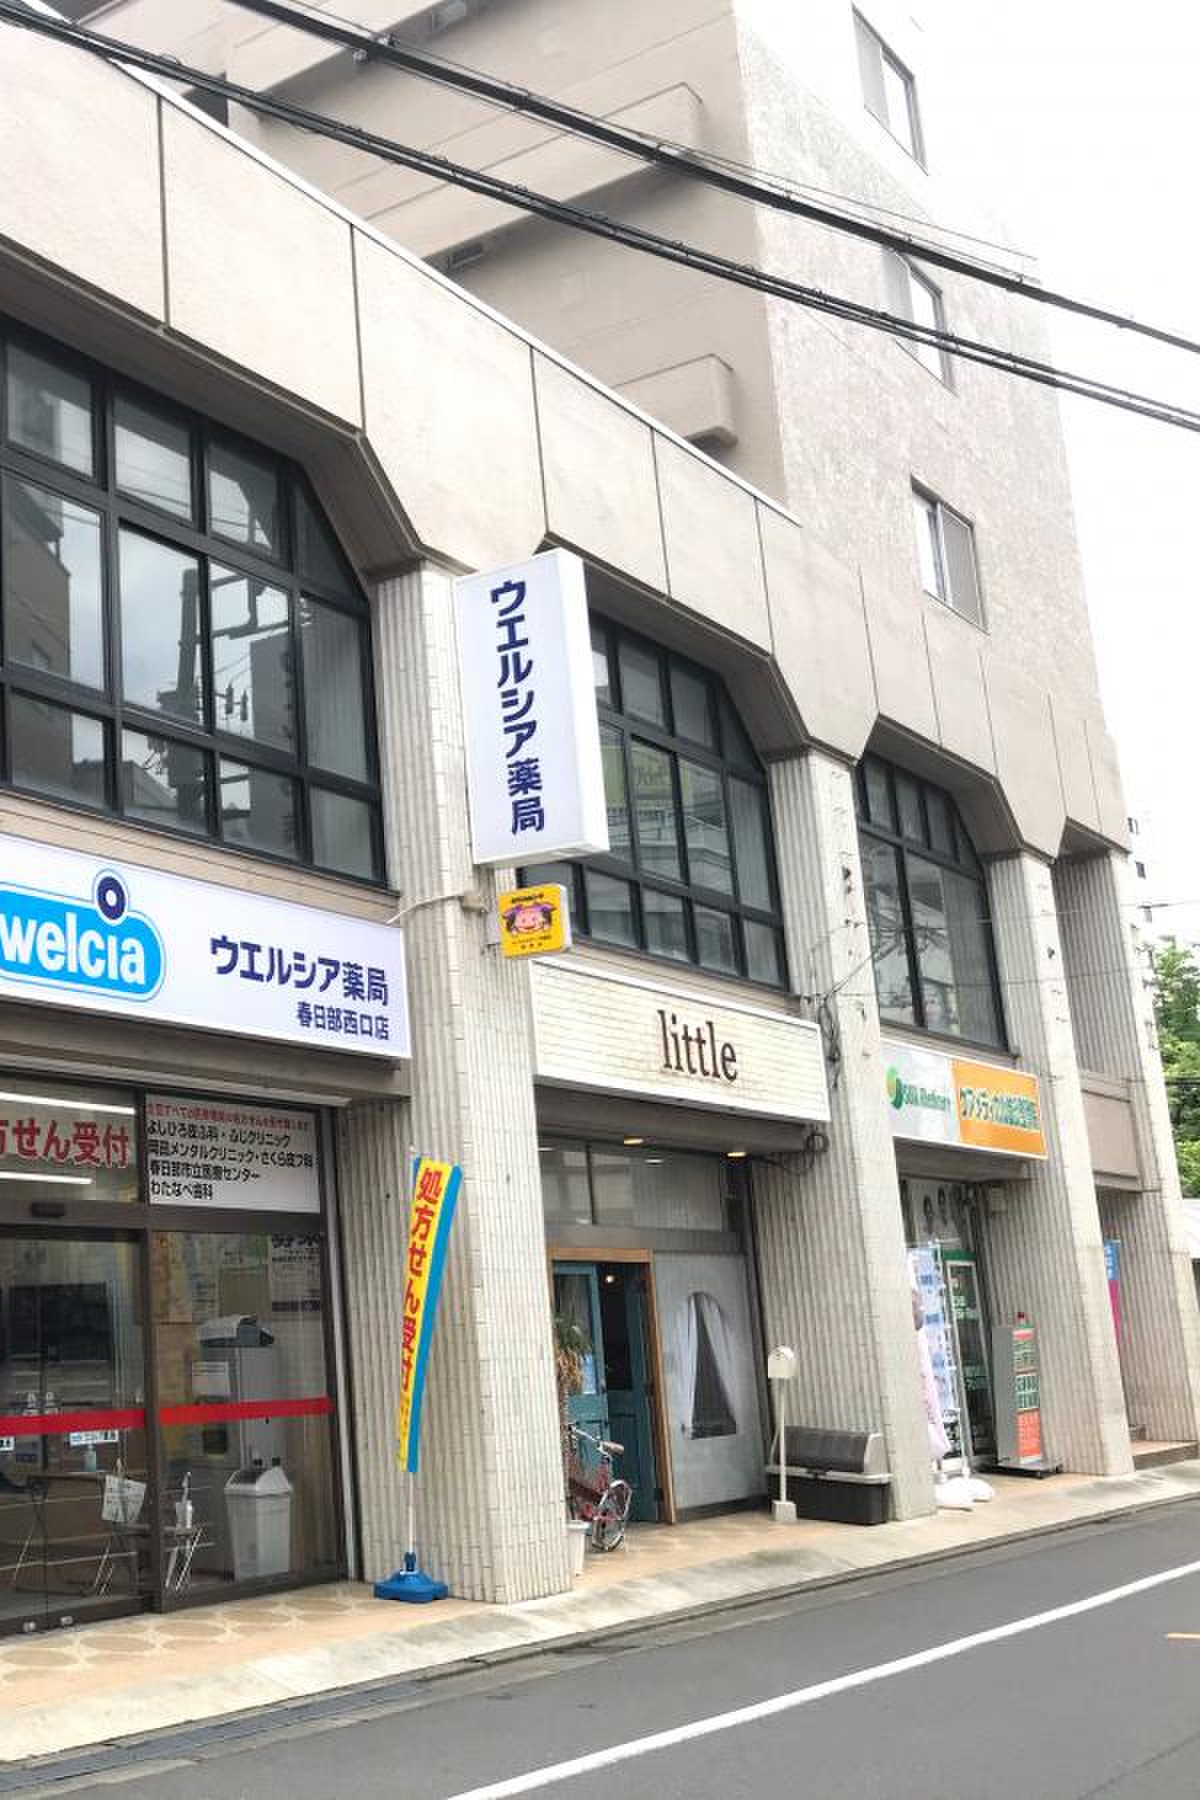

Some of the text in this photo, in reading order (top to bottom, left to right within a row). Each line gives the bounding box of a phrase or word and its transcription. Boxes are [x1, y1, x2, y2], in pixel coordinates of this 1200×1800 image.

[490, 580, 544, 836] ウエルシア薬局
[209, 934, 390, 1007] ウエルシア薬局
[296, 1001, 391, 1042] 春日部西口店
[657, 1009, 738, 1082] little
